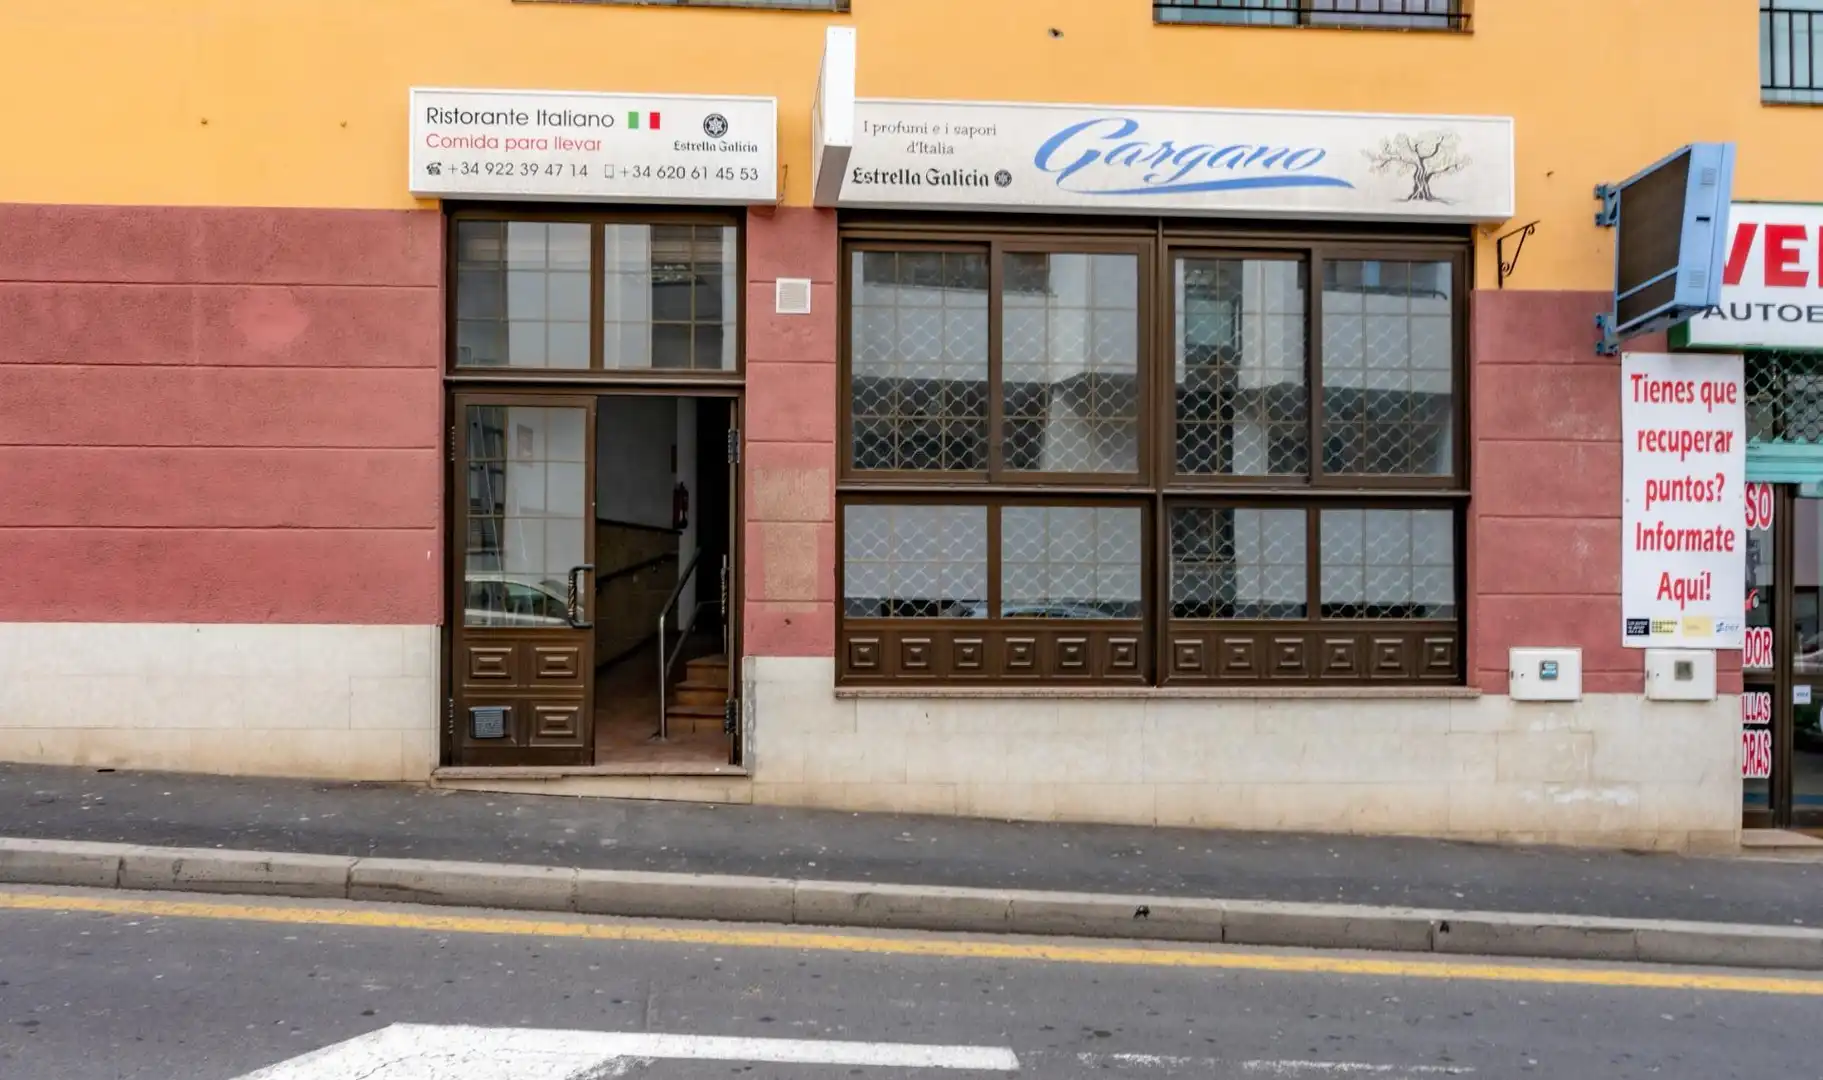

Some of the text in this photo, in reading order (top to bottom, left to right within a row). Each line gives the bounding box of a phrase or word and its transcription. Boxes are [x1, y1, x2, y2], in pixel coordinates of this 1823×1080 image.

[426, 106, 615, 128] Ristorante Italiano
[872, 121, 928, 137] profumi
[932, 125, 941, 134] e
[944, 122, 949, 135] i
[953, 124, 997, 138] sapori
[425, 133, 602, 153] Comida para llevar
[673, 140, 758, 153] Estrella Galicia
[906, 142, 955, 155] d'Italia
[1034, 117, 1357, 196] Gargano
[449, 162, 588, 177] +34 922 39 47 14
[620, 165, 759, 181] +34 620 61 45 53
[851, 167, 989, 187] Estrella Galicia
[1723, 222, 1823, 288] VE
[1631, 374, 1738, 413] Tienes que
[1637, 429, 1734, 461] recuperar
[1645, 473, 1725, 510] puntos?
[1636, 521, 1735, 553] Informate
